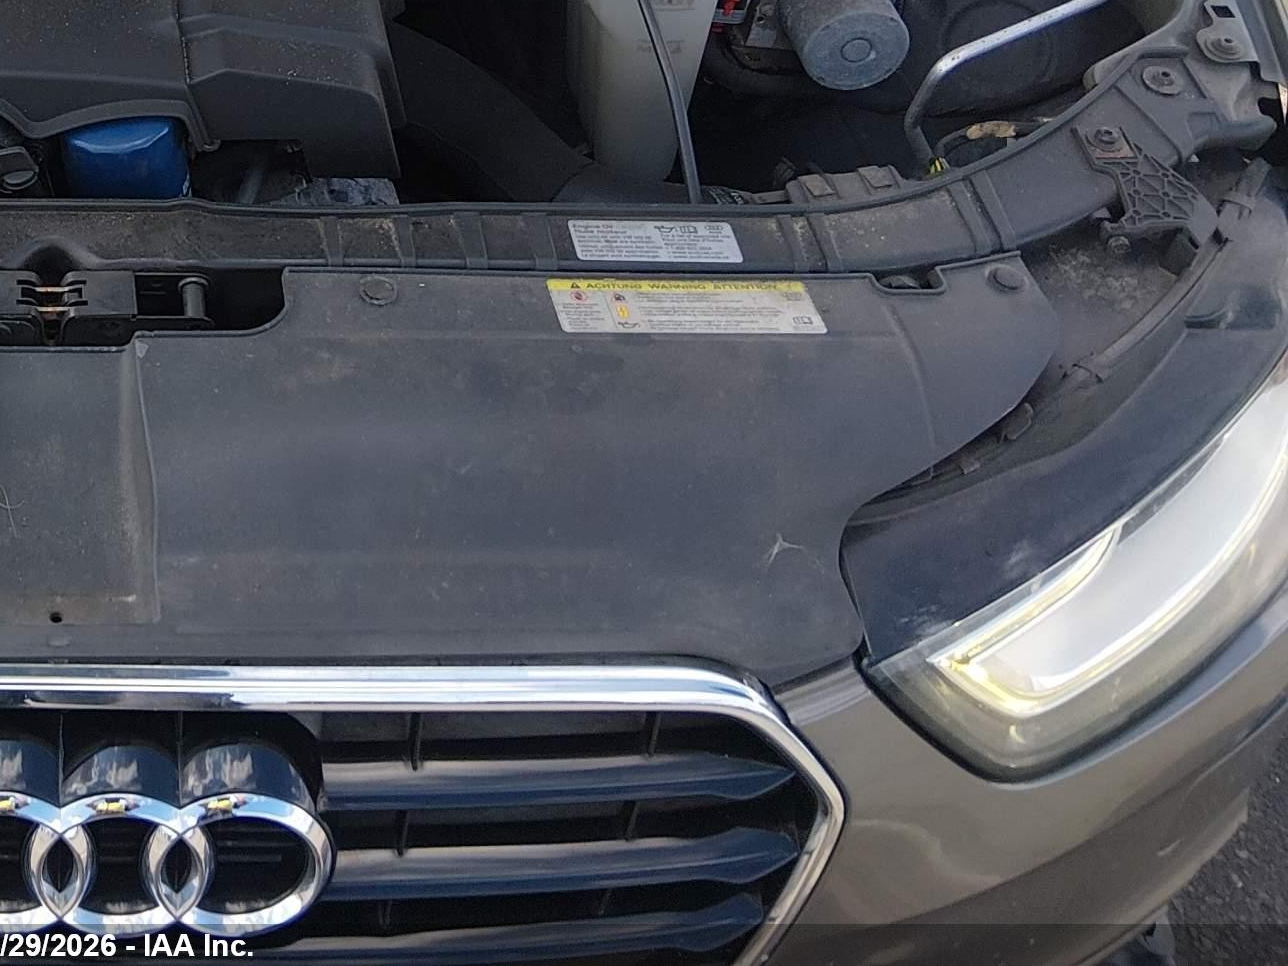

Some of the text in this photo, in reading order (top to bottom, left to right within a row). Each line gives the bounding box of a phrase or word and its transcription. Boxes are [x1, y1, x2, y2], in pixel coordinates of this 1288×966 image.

[586, 282, 778, 291] ACHTUNG WARNING ATTENTION
